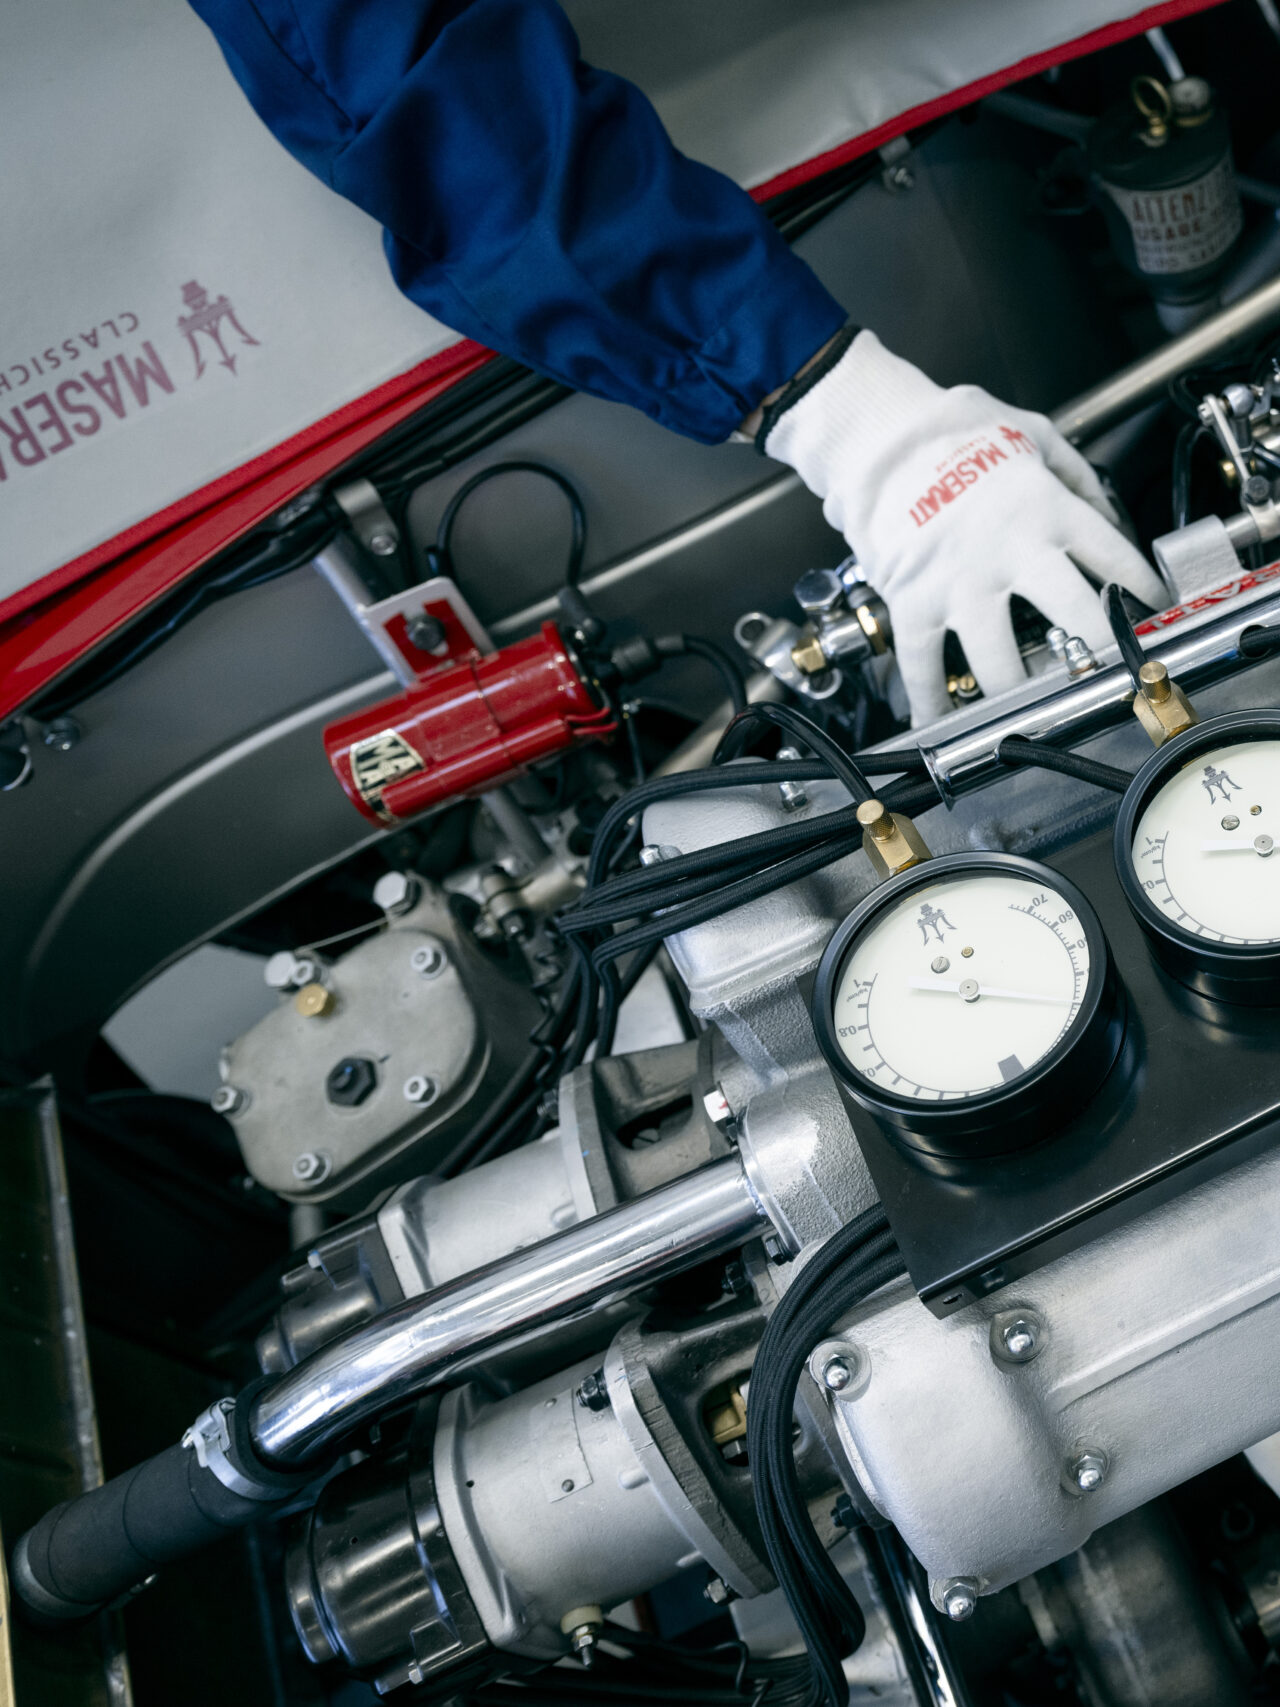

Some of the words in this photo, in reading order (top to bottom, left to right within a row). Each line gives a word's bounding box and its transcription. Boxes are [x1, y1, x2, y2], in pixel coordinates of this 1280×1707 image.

[0, 340, 176, 482] MASER
[908, 441, 1009, 529] MASERATI
[1032, 894, 1048, 907] 70
[1058, 910, 1074, 924] 60
[838, 1025, 857, 1038] 0.8
